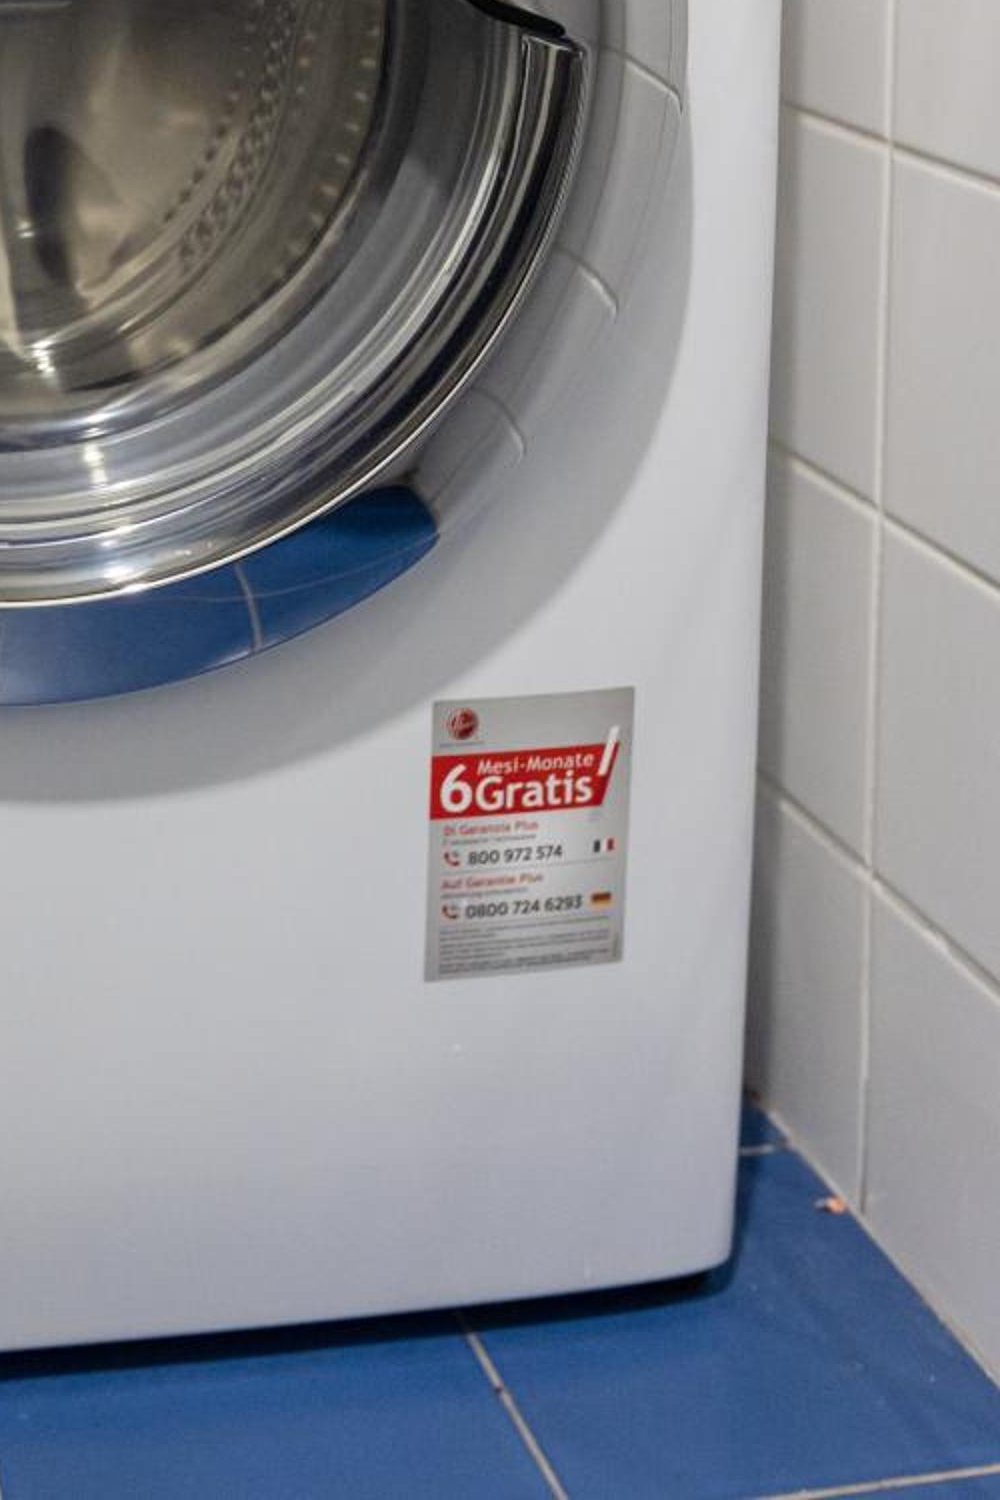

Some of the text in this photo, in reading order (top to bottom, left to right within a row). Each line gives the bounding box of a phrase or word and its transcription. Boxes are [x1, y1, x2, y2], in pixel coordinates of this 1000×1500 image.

[476, 752, 595, 775] Mesi-Monate
[440, 763, 593, 813] 6 Gratis
[468, 844, 563, 865] 800 972 574
[465, 895, 583, 919] 0800 724 6293
